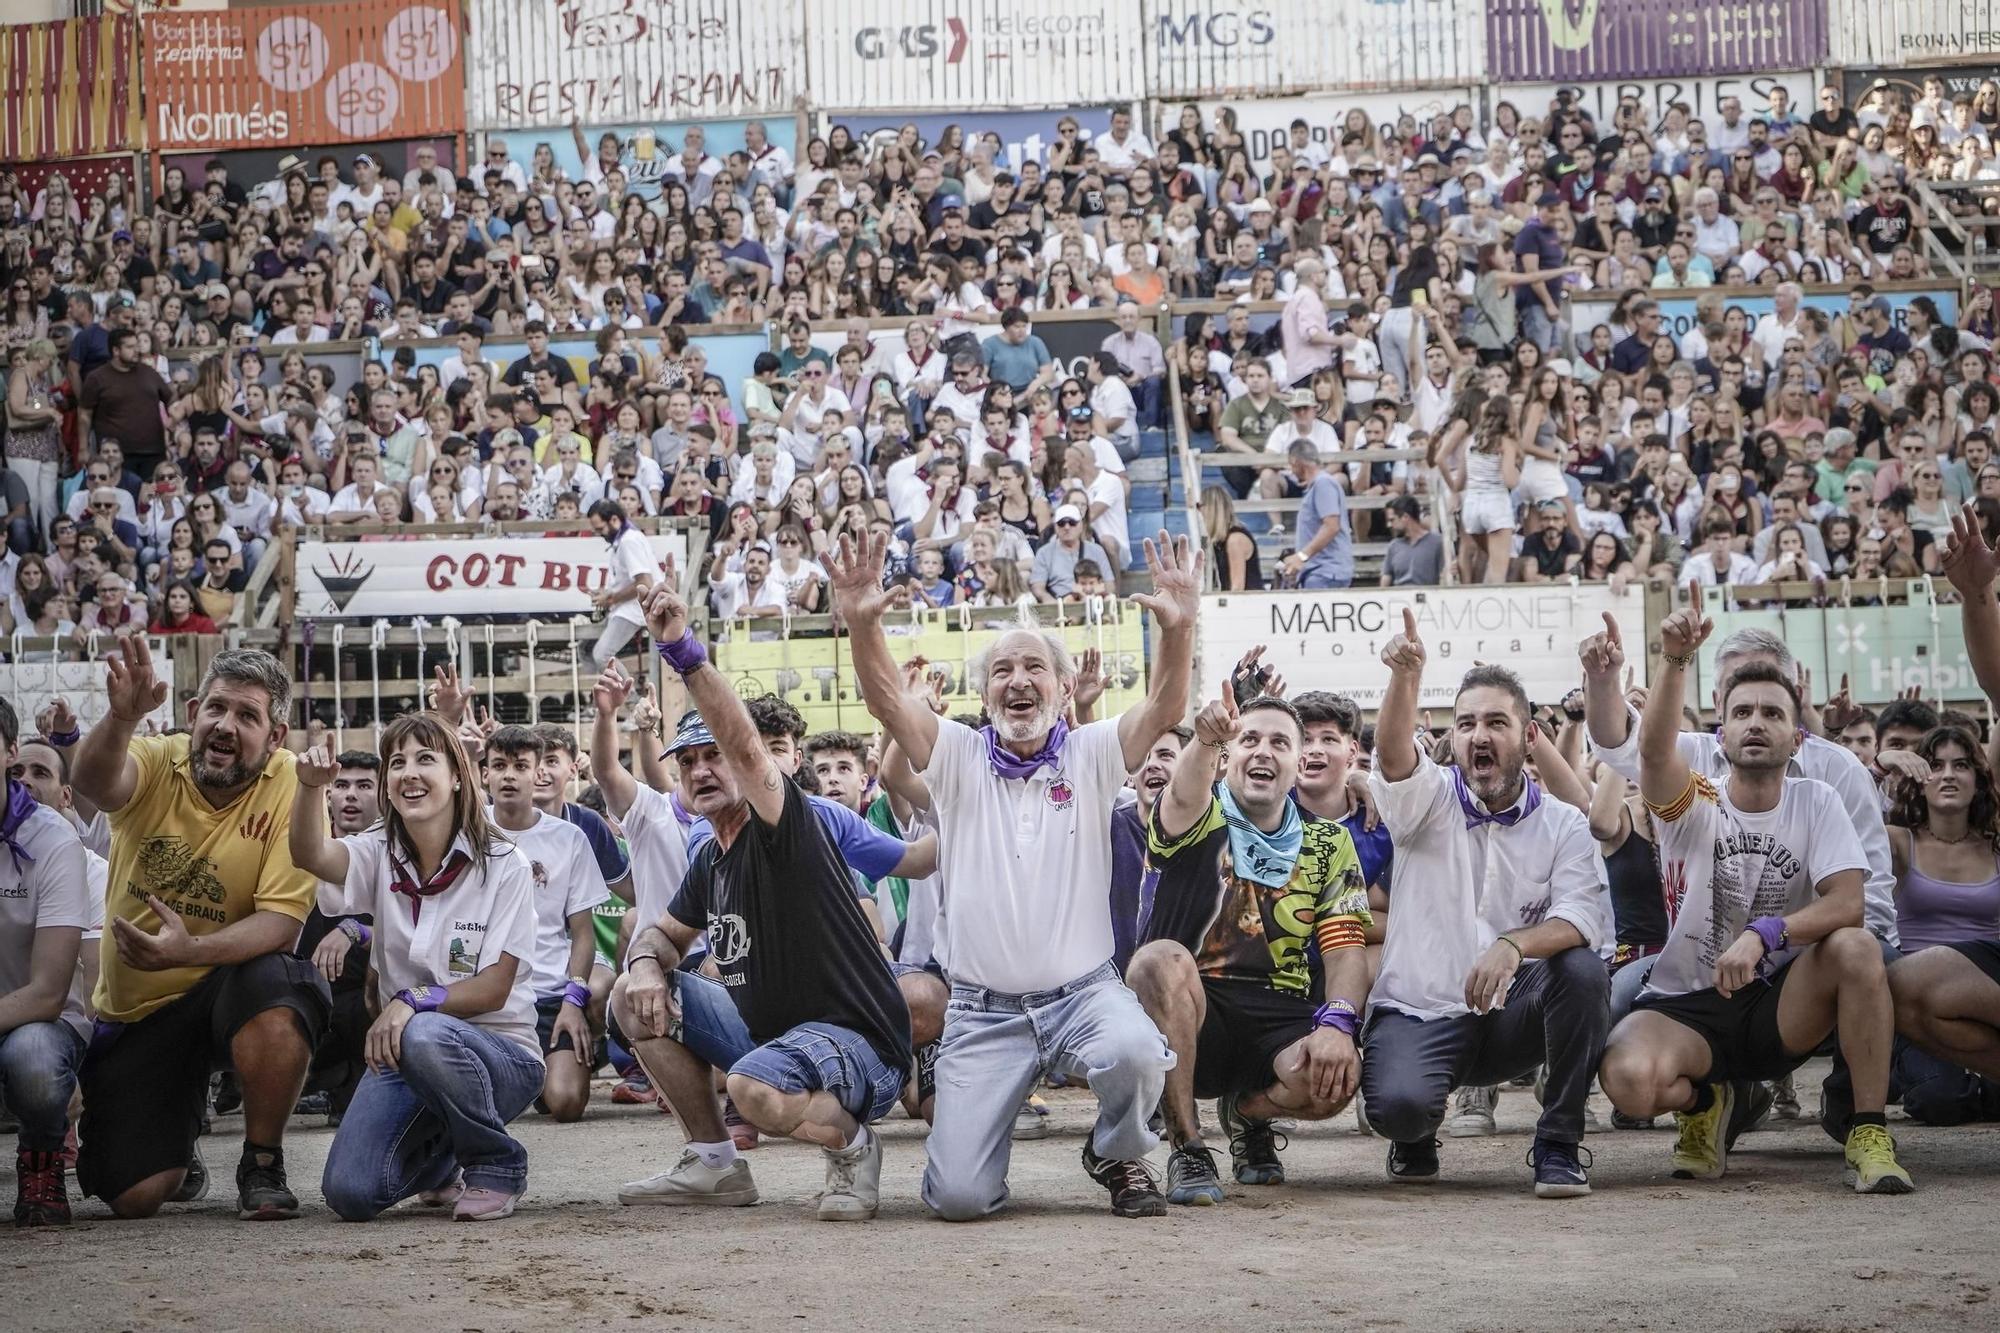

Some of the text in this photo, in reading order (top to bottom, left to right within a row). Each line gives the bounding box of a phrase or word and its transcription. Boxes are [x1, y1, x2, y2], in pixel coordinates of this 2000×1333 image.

[396, 21, 437, 61] sí
[984, 12, 1101, 36] telecom
[1158, 10, 1275, 48] MGS
[1900, 33, 1961, 48] BONA
[271, 32, 312, 70] sí
[339, 79, 386, 117] és
[159, 102, 289, 142] Només
[426, 553, 526, 593] GOT
[1300, 635, 1554, 658] fotgraf
[1870, 654, 1980, 692] Hàbi
[185, 903, 226, 924] BRAUS
